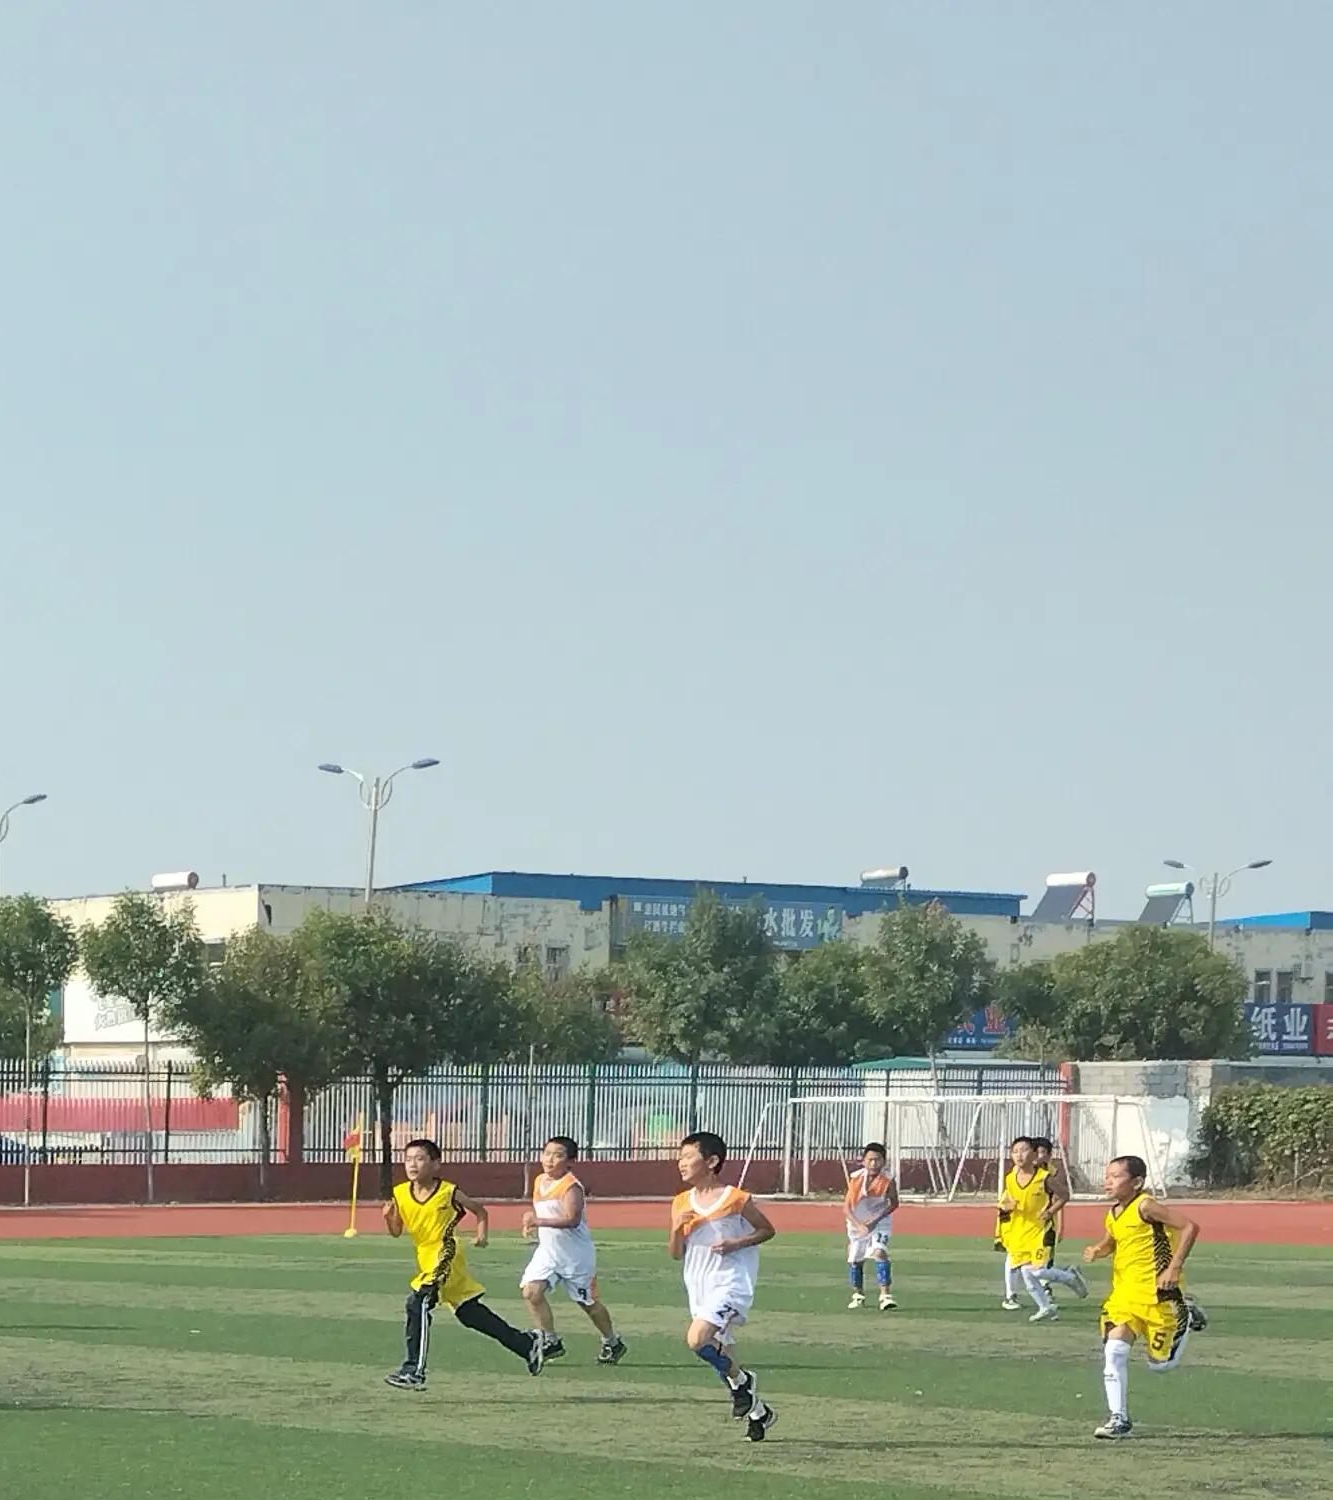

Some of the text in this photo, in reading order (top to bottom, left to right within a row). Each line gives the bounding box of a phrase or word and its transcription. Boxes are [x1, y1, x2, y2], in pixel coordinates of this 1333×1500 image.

[763, 906, 814, 938] 水批发
[1250, 1006, 1309, 1041] 纸业
[1151, 1331, 1167, 1351] 5
